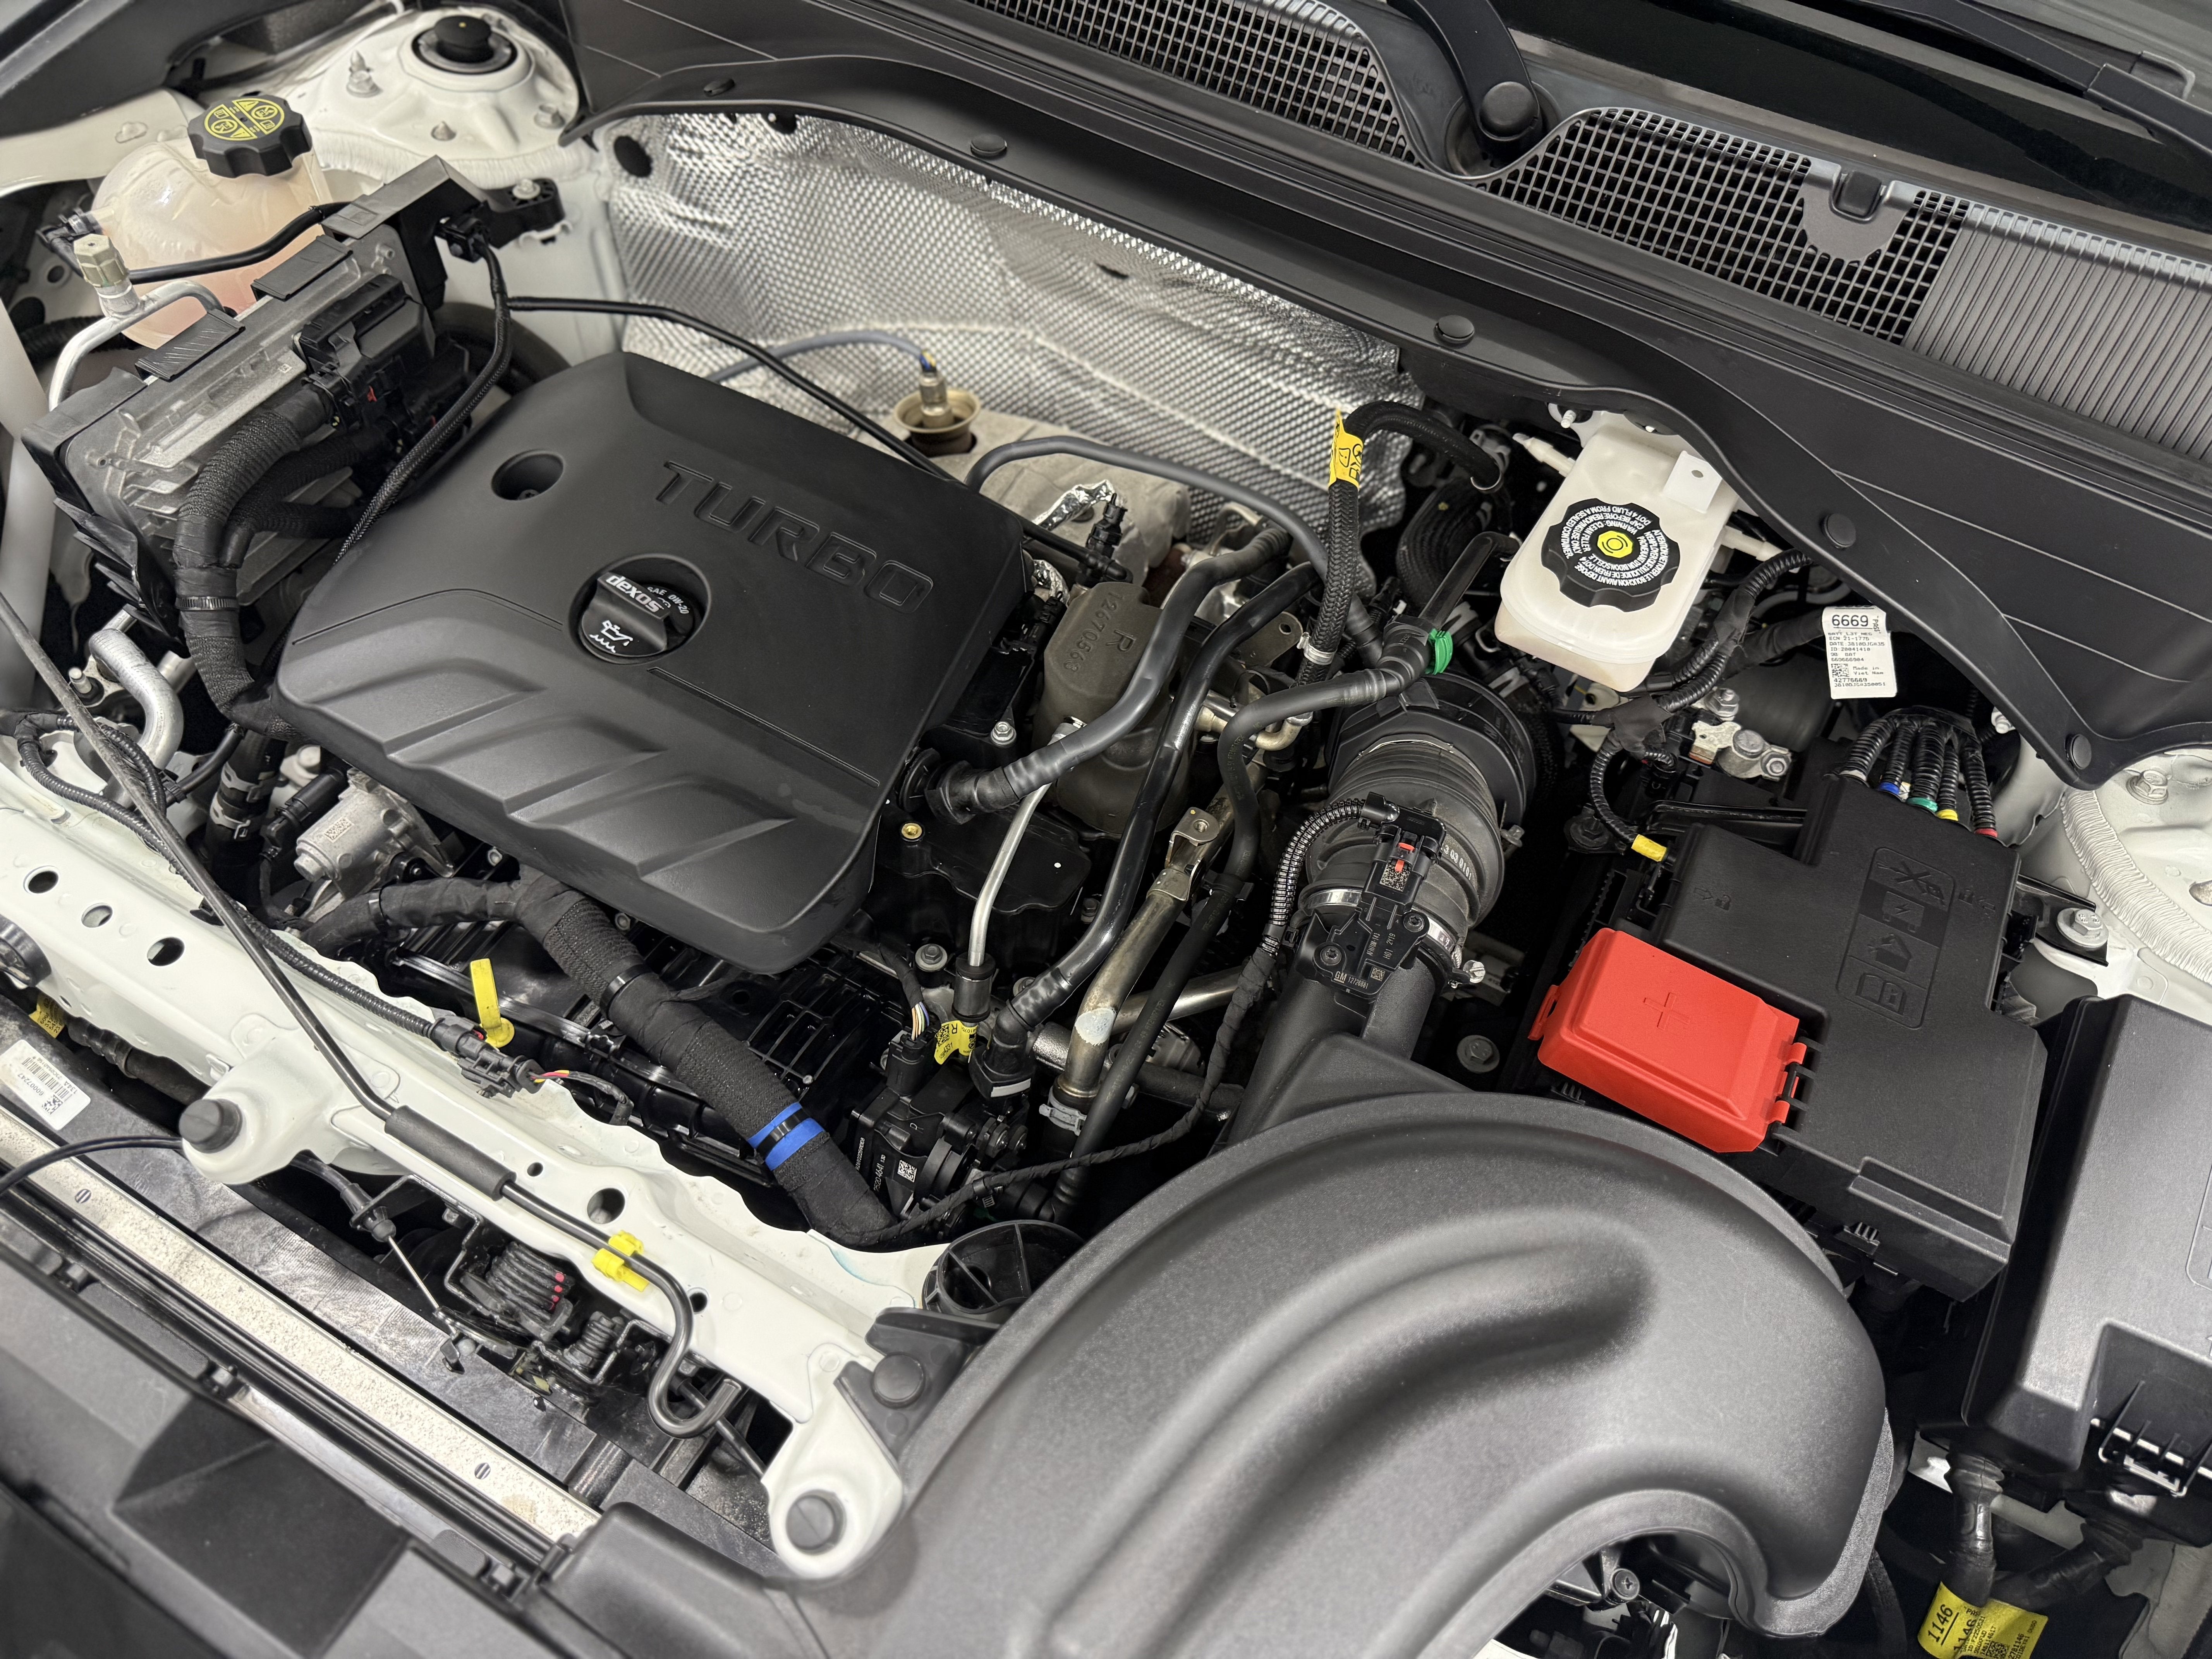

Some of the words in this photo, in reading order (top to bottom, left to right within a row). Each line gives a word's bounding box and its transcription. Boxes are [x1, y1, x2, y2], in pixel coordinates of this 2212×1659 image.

[1566, 510, 1587, 527] SEALED
[1602, 512, 1632, 523] BEFORE
[1612, 506, 1633, 517] FLUID
[1603, 520, 1638, 535] WARNING:
[1629, 520, 1645, 530] CAP
[1635, 515, 1651, 526] DOT
[1584, 521, 1604, 535] CLEAN
[656, 461, 934, 614] TURBO
[1581, 533, 1591, 552] FILLER
[1571, 540, 1583, 554] ONLY
[1582, 560, 1596, 570] DOT
[1588, 553, 1611, 570] SCELLE
[1639, 565, 1650, 574] DU
[1643, 572, 1654, 581] LE
[1596, 575, 1618, 586] AVANT
[1618, 576, 1647, 586] BOUCHON
[606, 575, 663, 613] dexos
[647, 586, 667, 596] SAE
[668, 594, 690, 614] 0W-20
[1832, 615, 1869, 627] 6669
[1106, 630, 1136, 651] R
[1335, 971, 1347, 982] GM
[951, 1023, 958, 1034] R
[18, 1073, 44, 1096] 60007247
[64, 1080, 77, 1094] 134A
[1928, 1604, 1953, 1642] 1146
